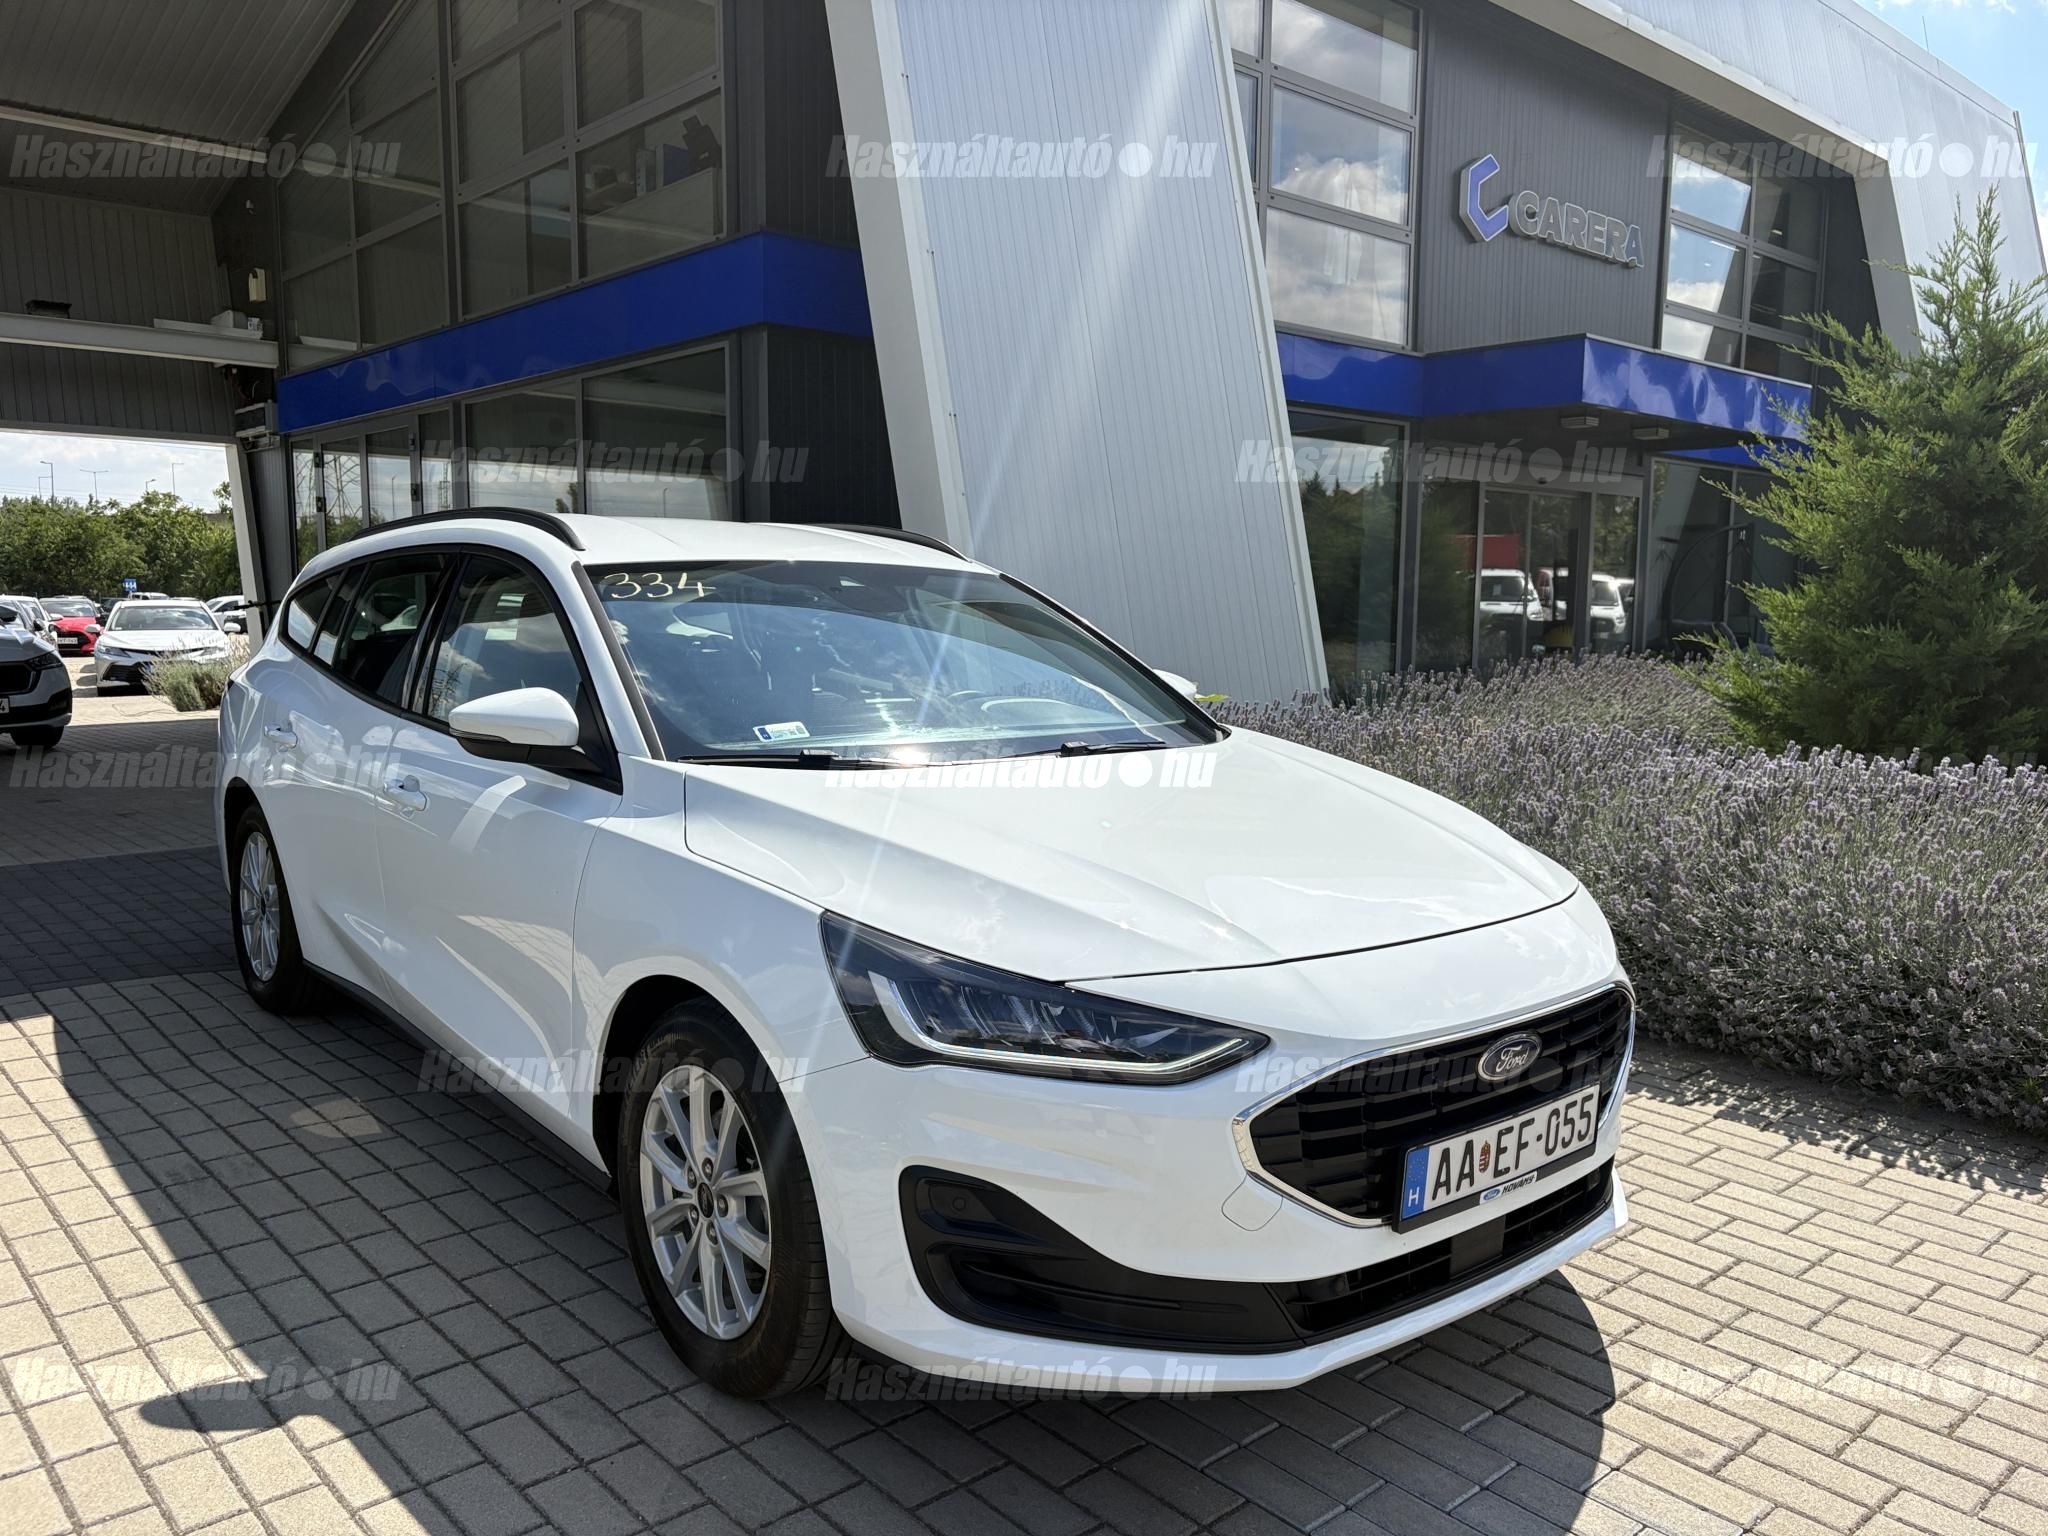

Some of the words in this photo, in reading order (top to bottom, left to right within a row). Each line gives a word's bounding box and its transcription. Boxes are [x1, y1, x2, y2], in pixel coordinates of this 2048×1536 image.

[1508, 190, 1644, 268] CARERA
[604, 572, 716, 599] 334
[1407, 1186, 1420, 1208] H
